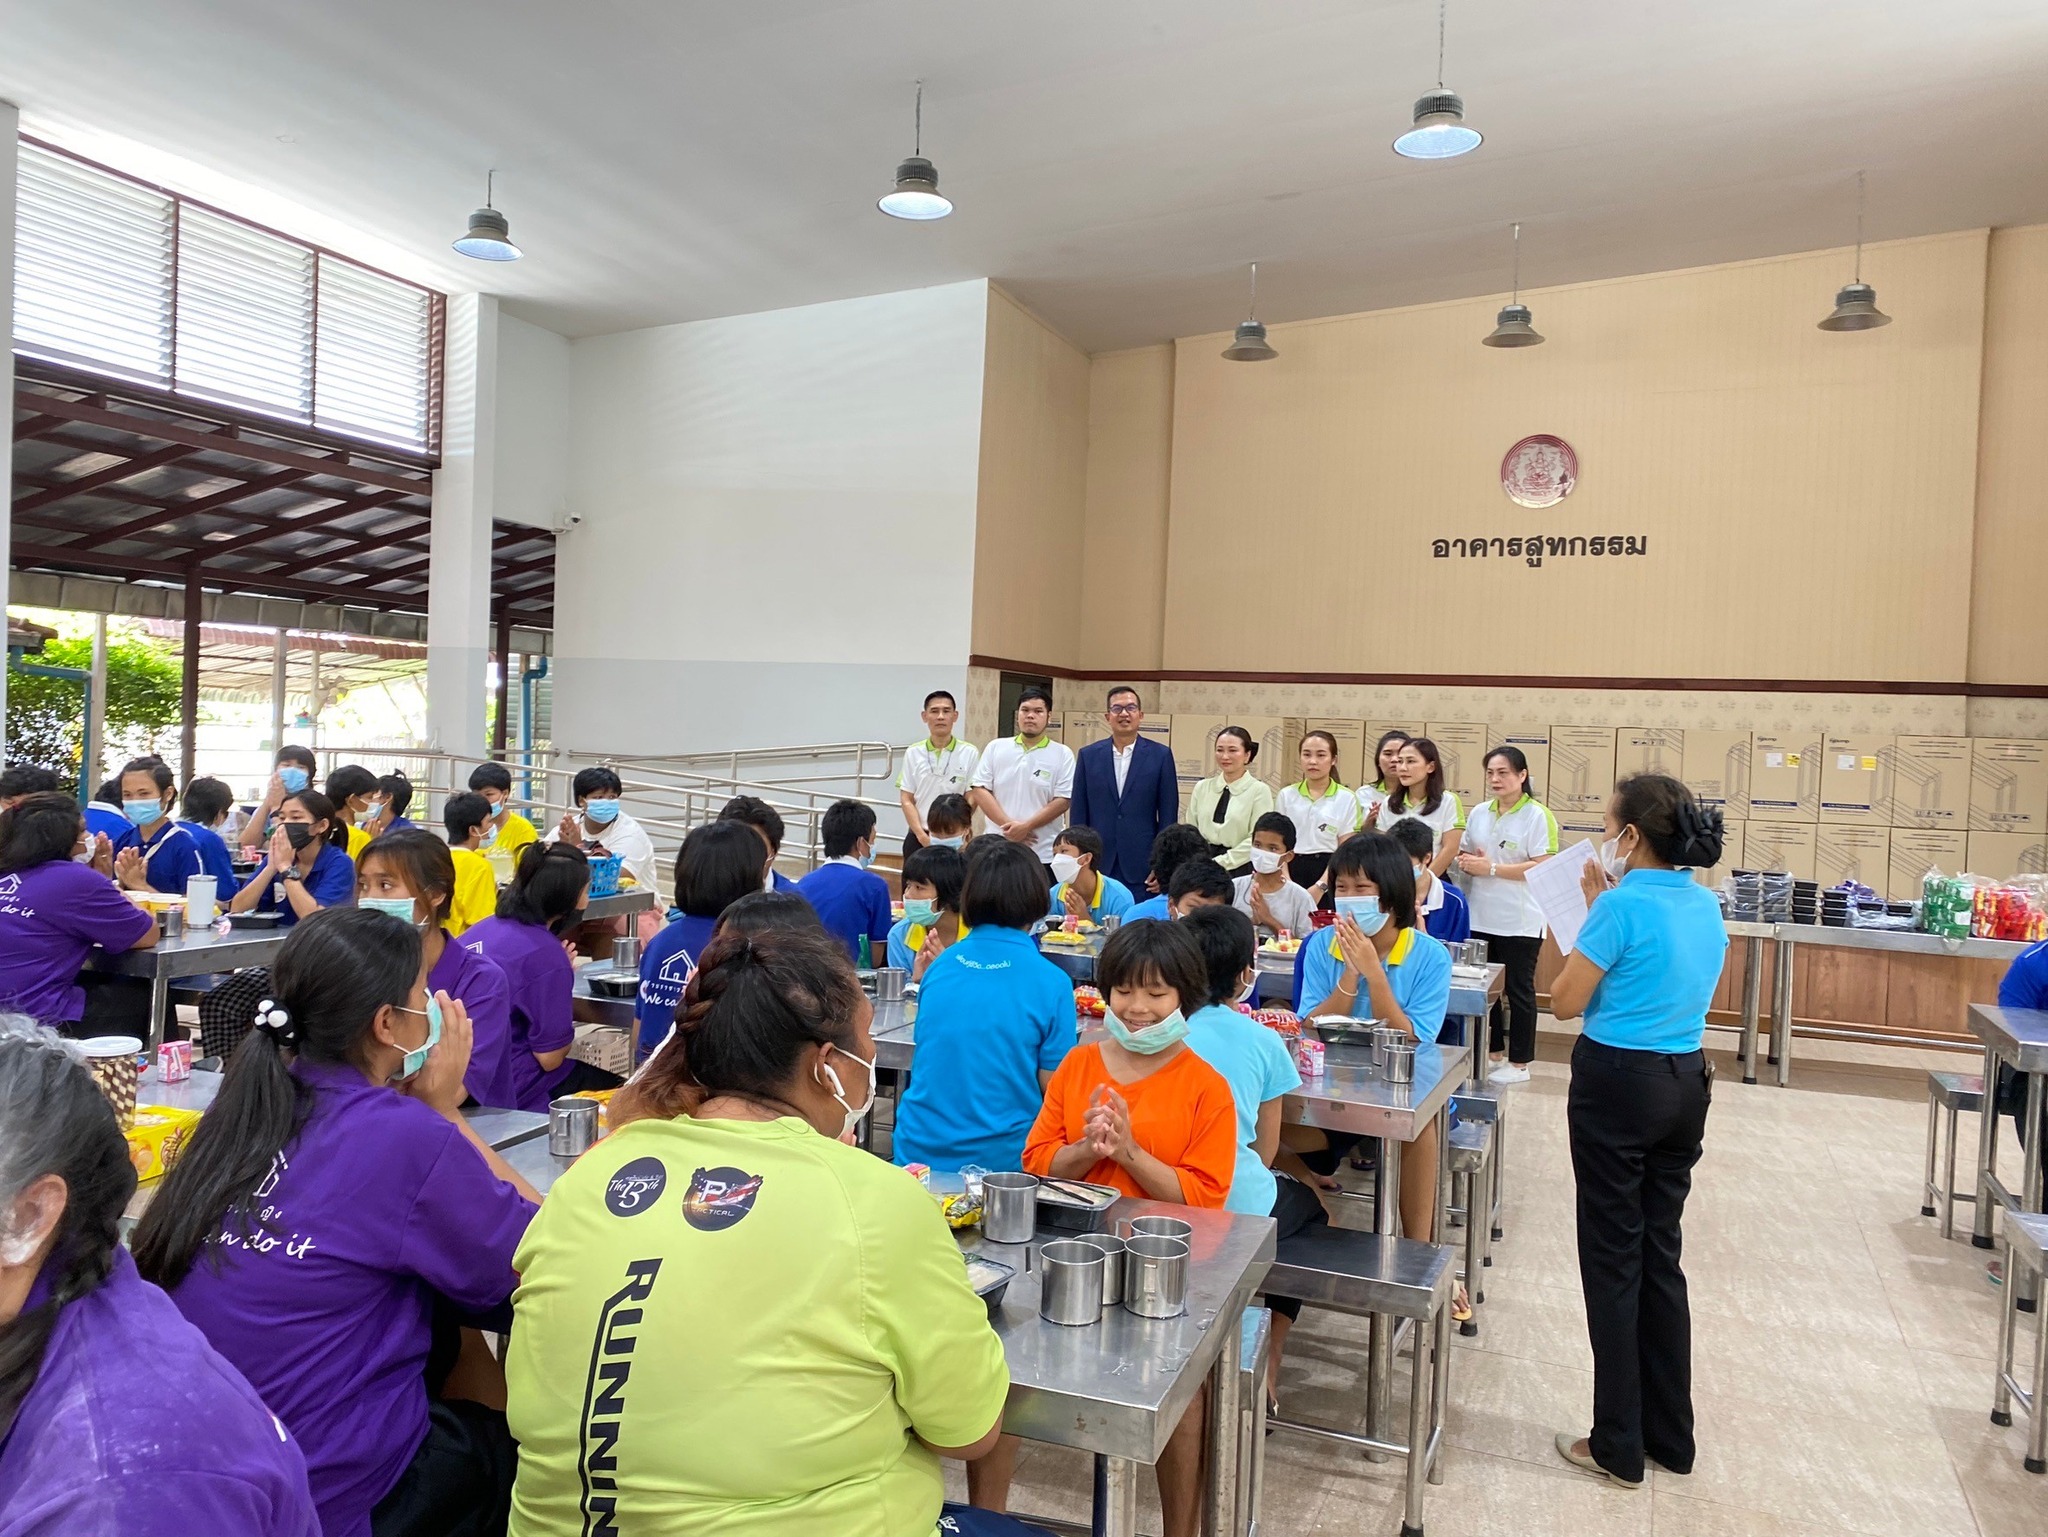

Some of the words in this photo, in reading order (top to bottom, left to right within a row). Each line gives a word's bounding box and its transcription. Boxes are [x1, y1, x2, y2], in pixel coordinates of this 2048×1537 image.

[1431, 535, 1647, 567] อาคารสูทกรรม
[21, 907, 35, 918] it
[645, 993, 663, 1005] We
[664, 998, 678, 1006] ca
[609, 1179, 626, 1192] The
[286, 1233, 316, 1259] it
